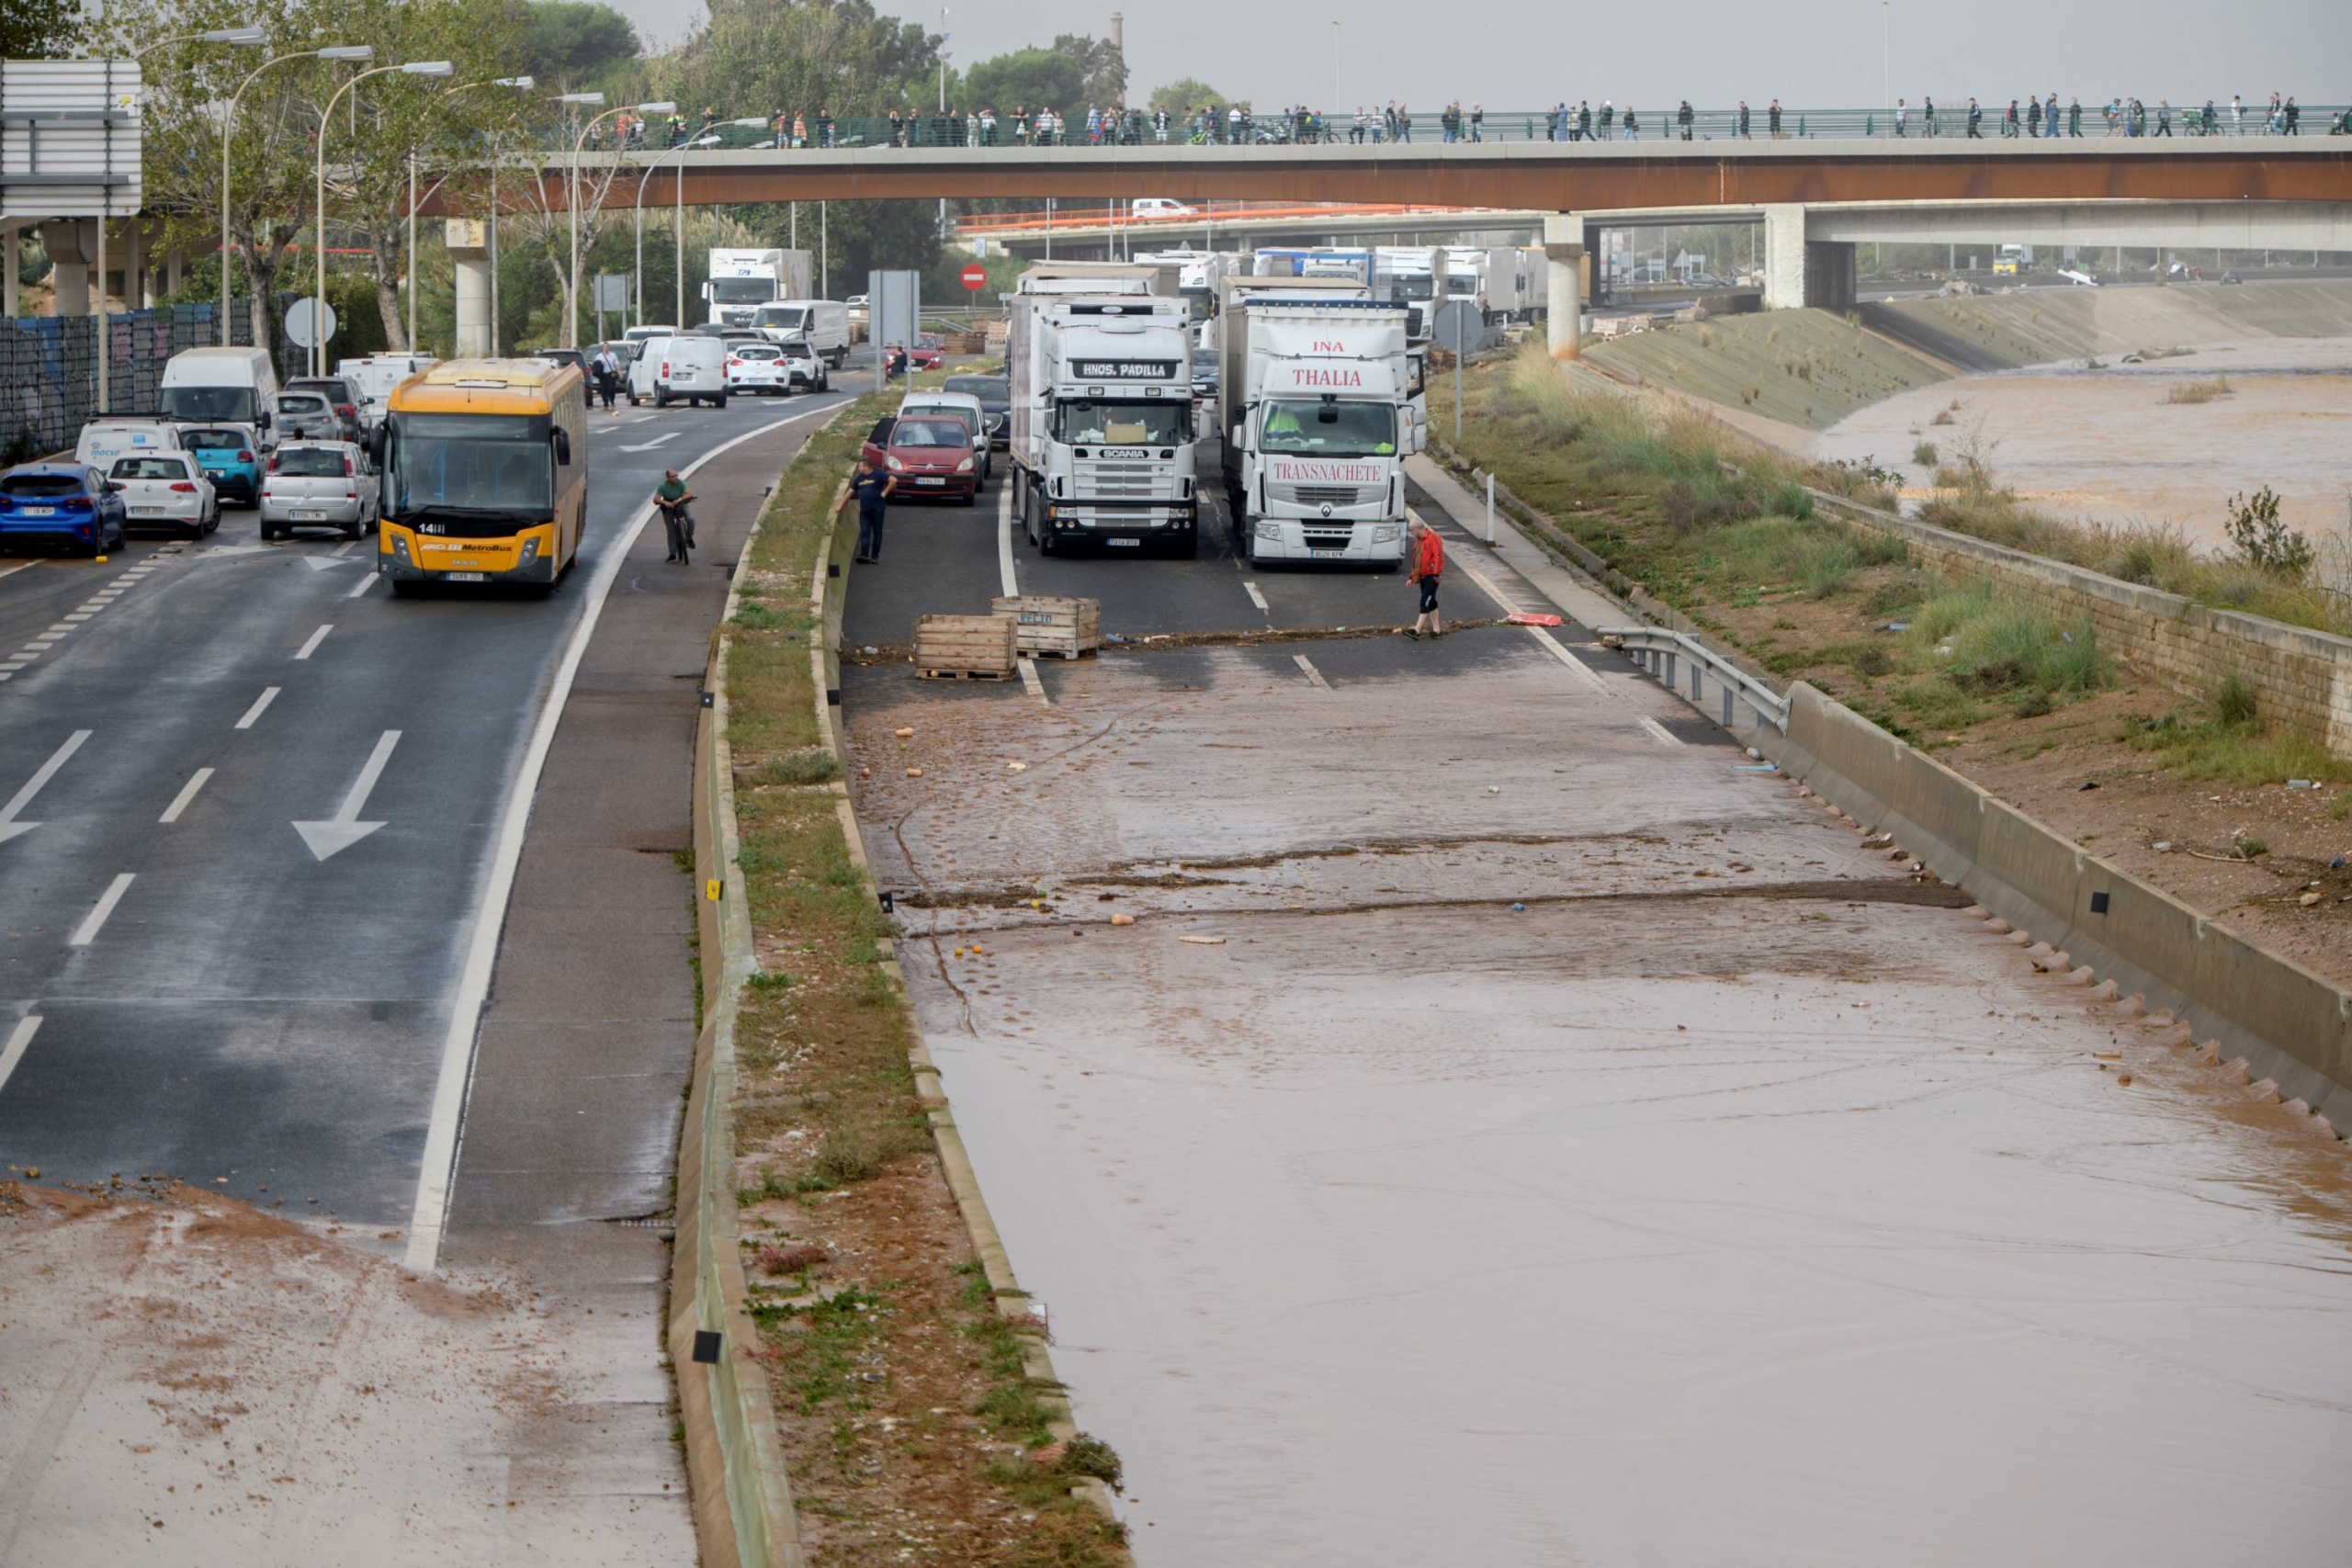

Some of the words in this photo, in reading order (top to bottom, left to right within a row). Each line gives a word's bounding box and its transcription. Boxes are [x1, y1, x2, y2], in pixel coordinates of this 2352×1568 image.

[1313, 341, 1344, 352] INA
[1083, 363, 1117, 376] HNOS.
[1119, 364, 1165, 378] PADILLA
[1293, 369, 1362, 387] THALIA
[1103, 450, 1145, 458] SCANIA
[1274, 463, 1381, 481] TRANSNACHETE
[461, 544, 512, 552] MetroBus
